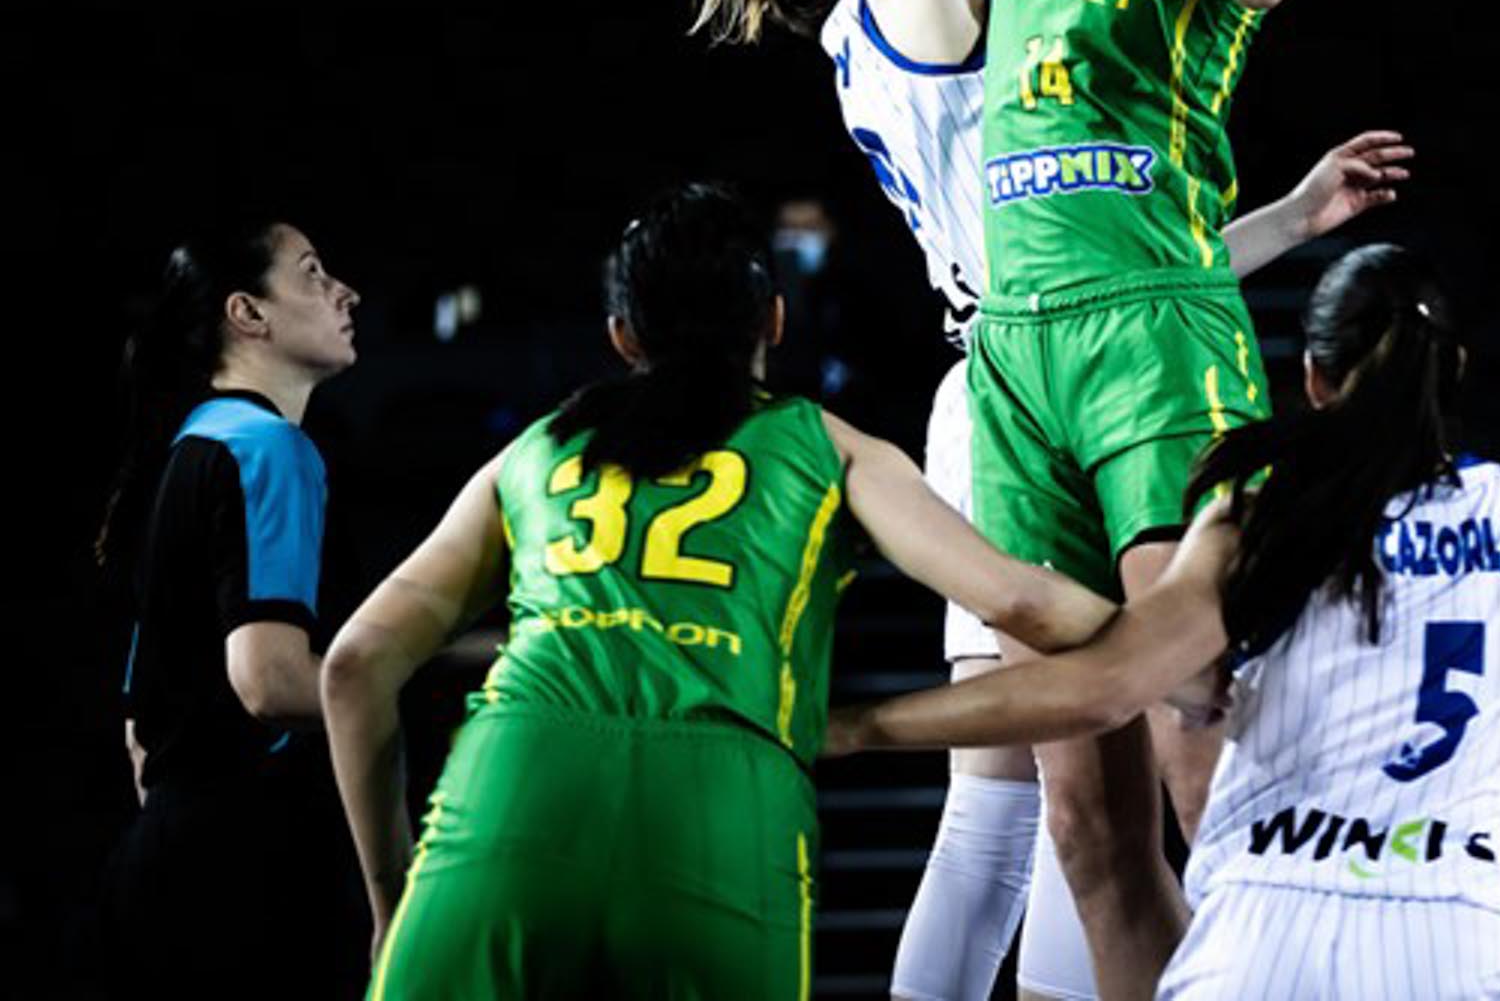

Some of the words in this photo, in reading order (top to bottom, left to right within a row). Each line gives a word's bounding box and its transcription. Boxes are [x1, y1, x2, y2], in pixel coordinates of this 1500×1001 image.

[1019, 35, 1074, 111] 14
[544, 449, 747, 588] 32
[1381, 620, 1487, 783] 5
